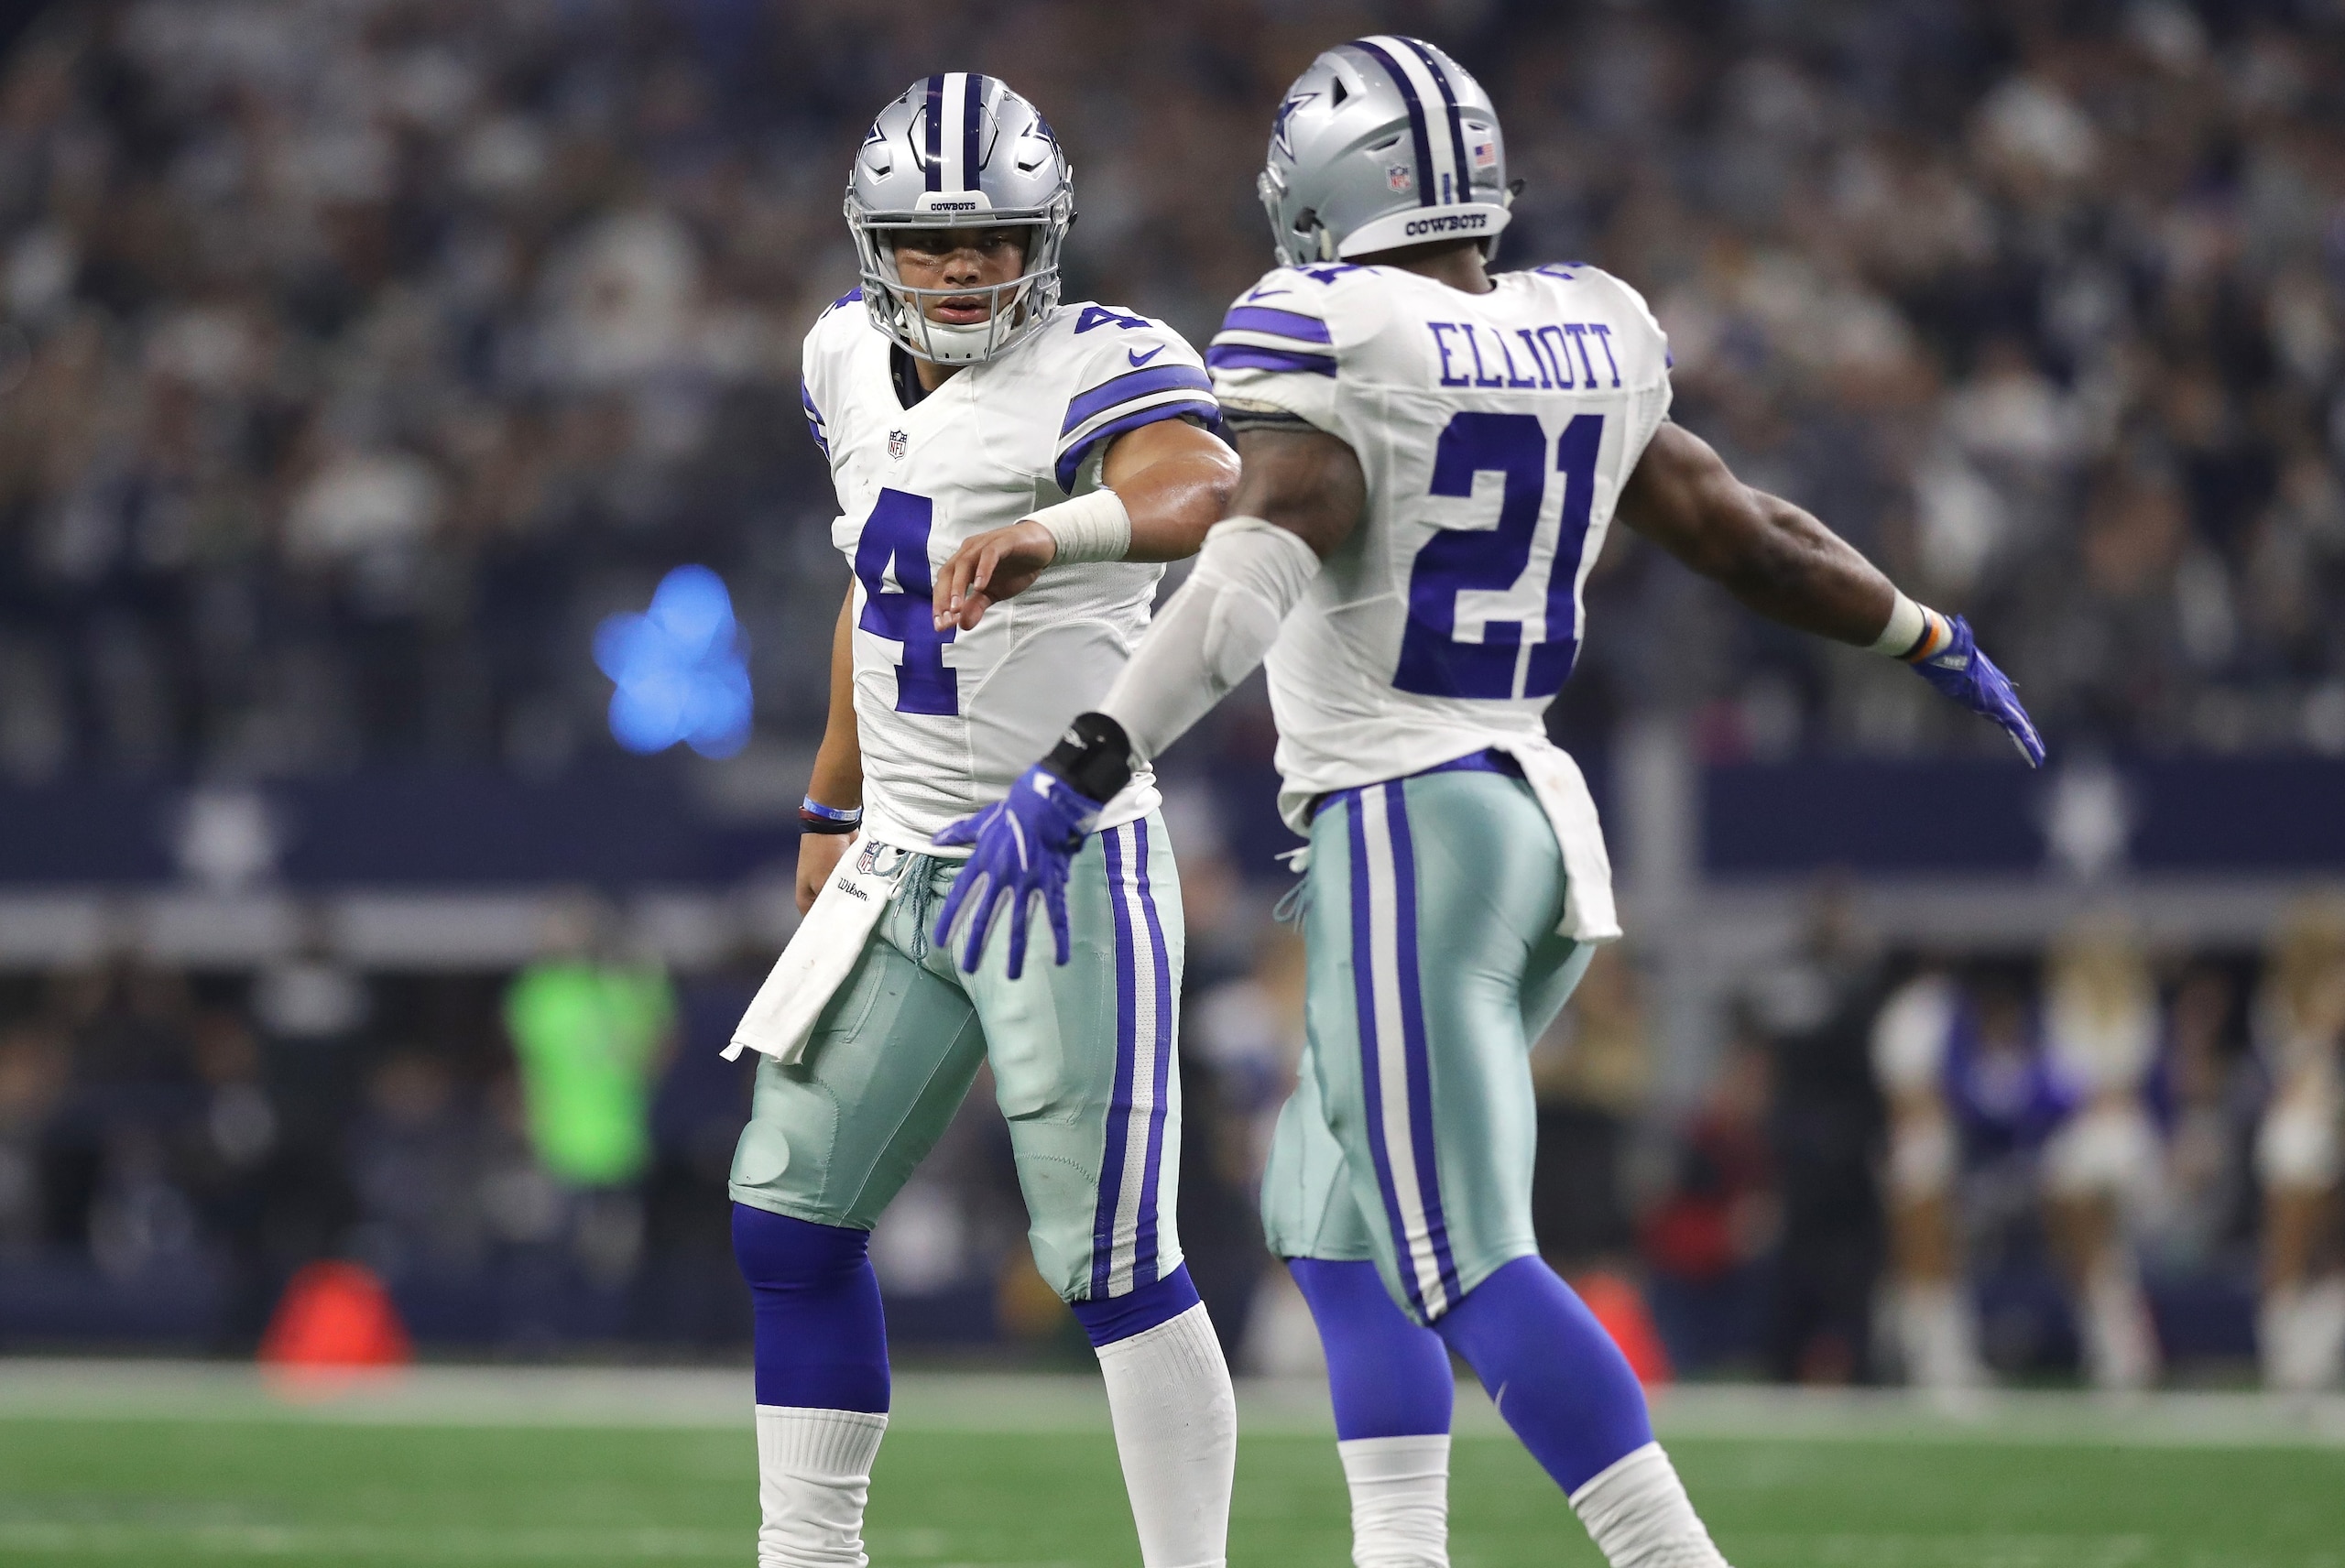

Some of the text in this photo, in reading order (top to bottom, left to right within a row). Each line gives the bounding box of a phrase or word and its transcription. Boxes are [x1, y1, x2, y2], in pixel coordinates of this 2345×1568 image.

[931, 202, 976, 211] COWBOYS
[1406, 213, 1487, 235] COWBOYS
[1074, 306, 1154, 334] 4
[1427, 322, 1620, 390] ELLIOTT
[1391, 410, 1605, 701] 21
[855, 487, 959, 716] 4
[837, 877, 868, 902] Wilson
